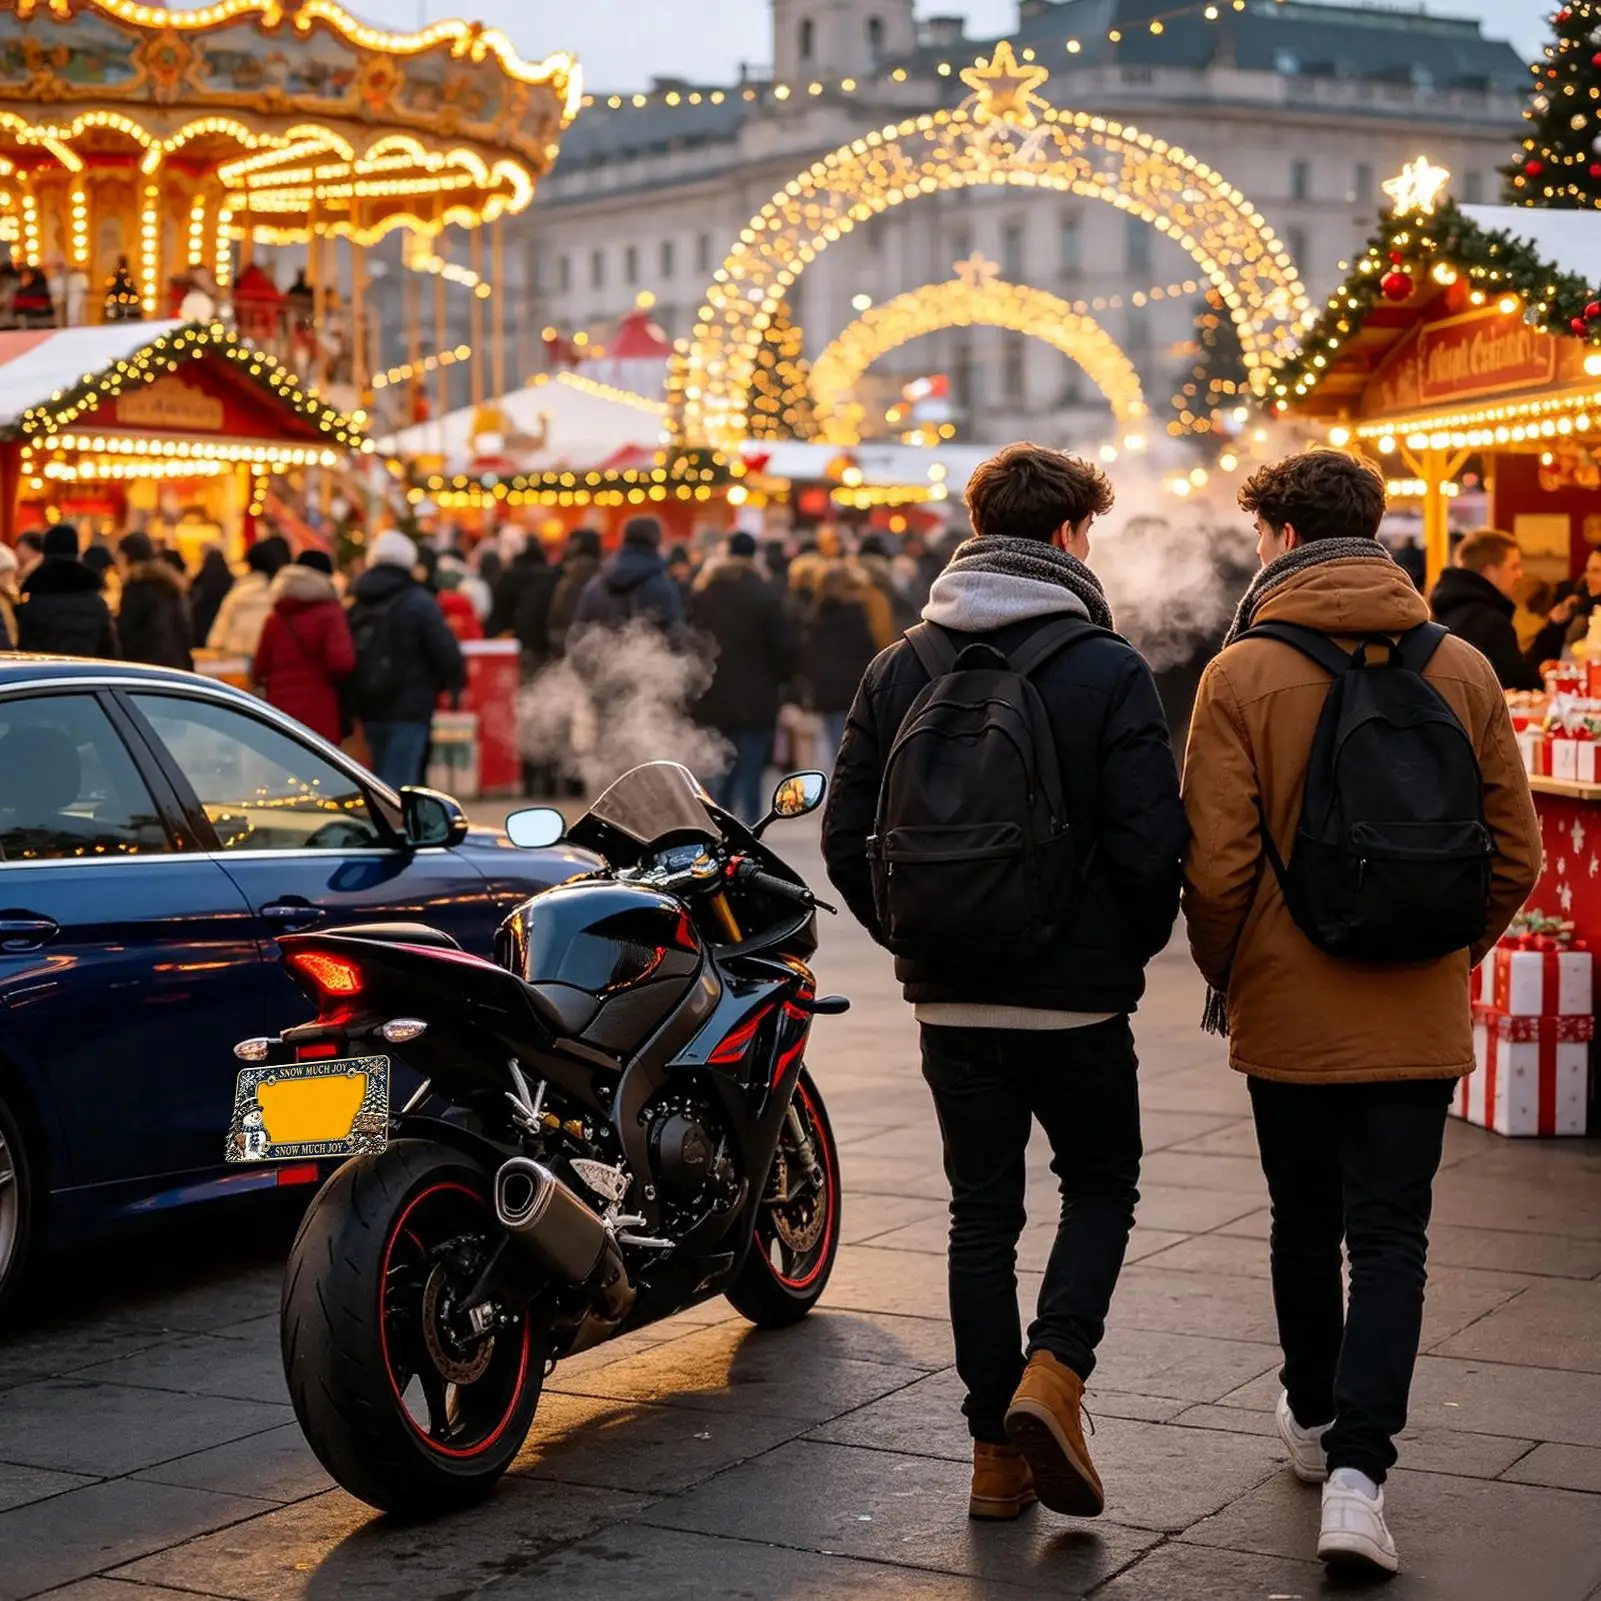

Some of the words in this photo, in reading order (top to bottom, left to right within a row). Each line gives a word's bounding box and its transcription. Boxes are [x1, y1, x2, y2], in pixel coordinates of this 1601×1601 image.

[279, 1067, 303, 1078] SNOW
[305, 1065, 330, 1076] MUCH
[331, 1063, 348, 1074] JOY
[274, 1145, 299, 1157] SNOW
[301, 1143, 326, 1155] MUCH
[327, 1142, 344, 1153] JOY
